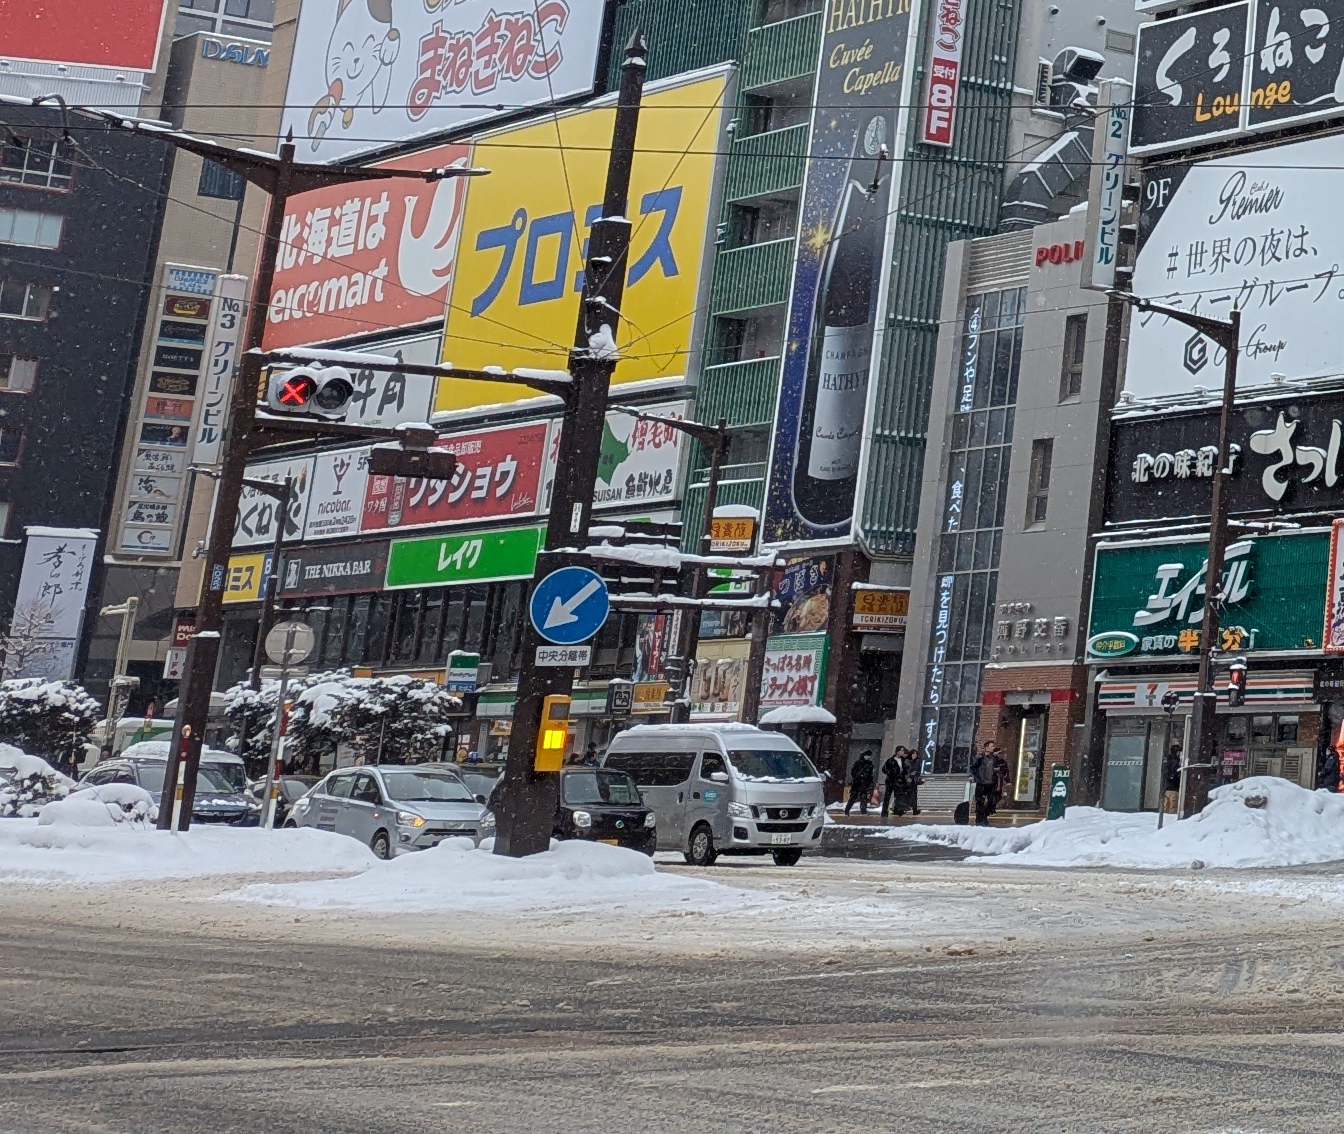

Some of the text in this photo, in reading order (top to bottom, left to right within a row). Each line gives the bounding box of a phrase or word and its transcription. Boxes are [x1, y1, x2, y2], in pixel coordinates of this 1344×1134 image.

[843, 60, 901, 96] Capella
[926, 63, 957, 143] 受付 8F
[1195, 78, 1292, 123] Lounge
[1096, 152, 1125, 266] グリーンビル
[1146, 177, 1172, 212] 9F
[276, 191, 391, 273] 北海道は
[197, 340, 235, 444] グリーンビル
[305, 565, 321, 580] THE
[322, 561, 351, 579] NIKKA
[437, 539, 484, 572] レイク
[538, 649, 589, 663] 中央分離帯
[1053, 769, 1071, 778] TAXI
